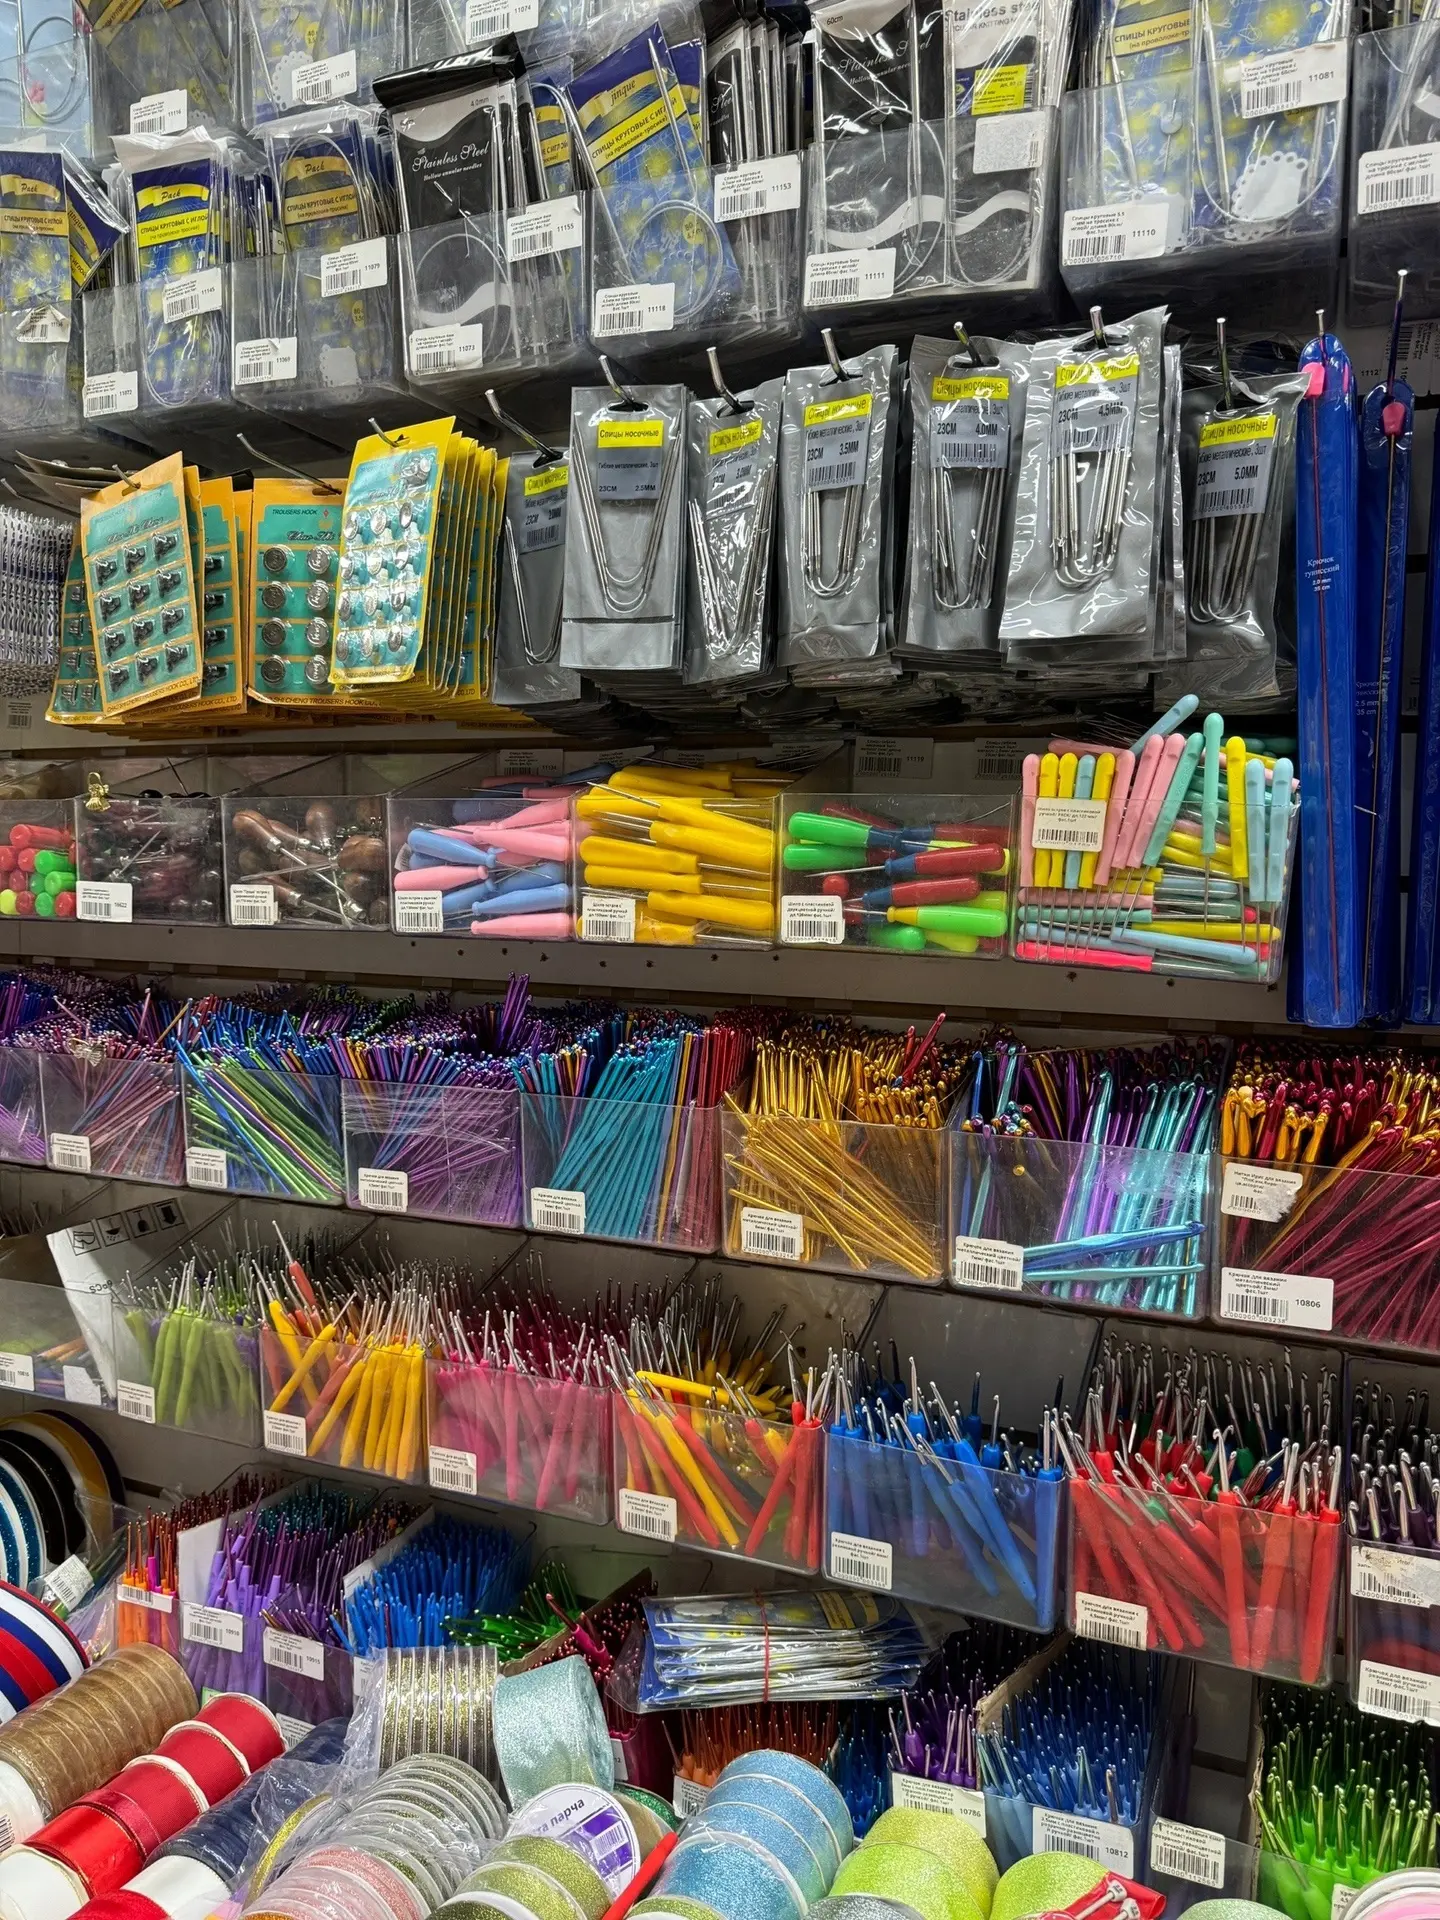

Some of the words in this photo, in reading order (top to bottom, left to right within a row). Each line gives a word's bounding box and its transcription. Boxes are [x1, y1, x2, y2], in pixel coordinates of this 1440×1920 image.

[1114, 30, 1144, 44] СПИЦЫ
[1308, 70, 1334, 82] 11081
[610, 80, 636, 107] jinque
[591, 138, 616, 159] СПИЦЫ
[615, 118, 649, 142] КРУГОВЫЕ
[412, 155, 458, 173] Stainless
[460, 142, 491, 161] Steel
[305, 161, 324, 174] Pack
[21, 183, 38, 193] Pack
[771, 182, 792, 193] 11153
[161, 190, 181, 202] Pack
[140, 225, 160, 234] СПИЦЫ
[160, 220, 185, 230] КРУГОВЫЕ
[557, 223, 575, 233] 11155
[1132, 228, 1156, 237] 11110
[865, 272, 885, 280] 11111
[936, 381, 961, 398] Спицы
[599, 429, 625, 439] Спицы
[625, 428, 660, 438] носочные
[1200, 427, 1226, 443] Спицы
[1226, 420, 1268, 436] носочные
[1307, 556, 1335, 567] Крючок
[1304, 564, 1341, 579] тунисский
[309, 697, 344, 705] TROUSERS
[1366, 708, 1377, 716] cm
[1295, 1298, 1321, 1309] 10806
[550, 1798, 586, 1828] парча
[959, 1806, 981, 1818] 10786
[1105, 1846, 1129, 1859] 10812
